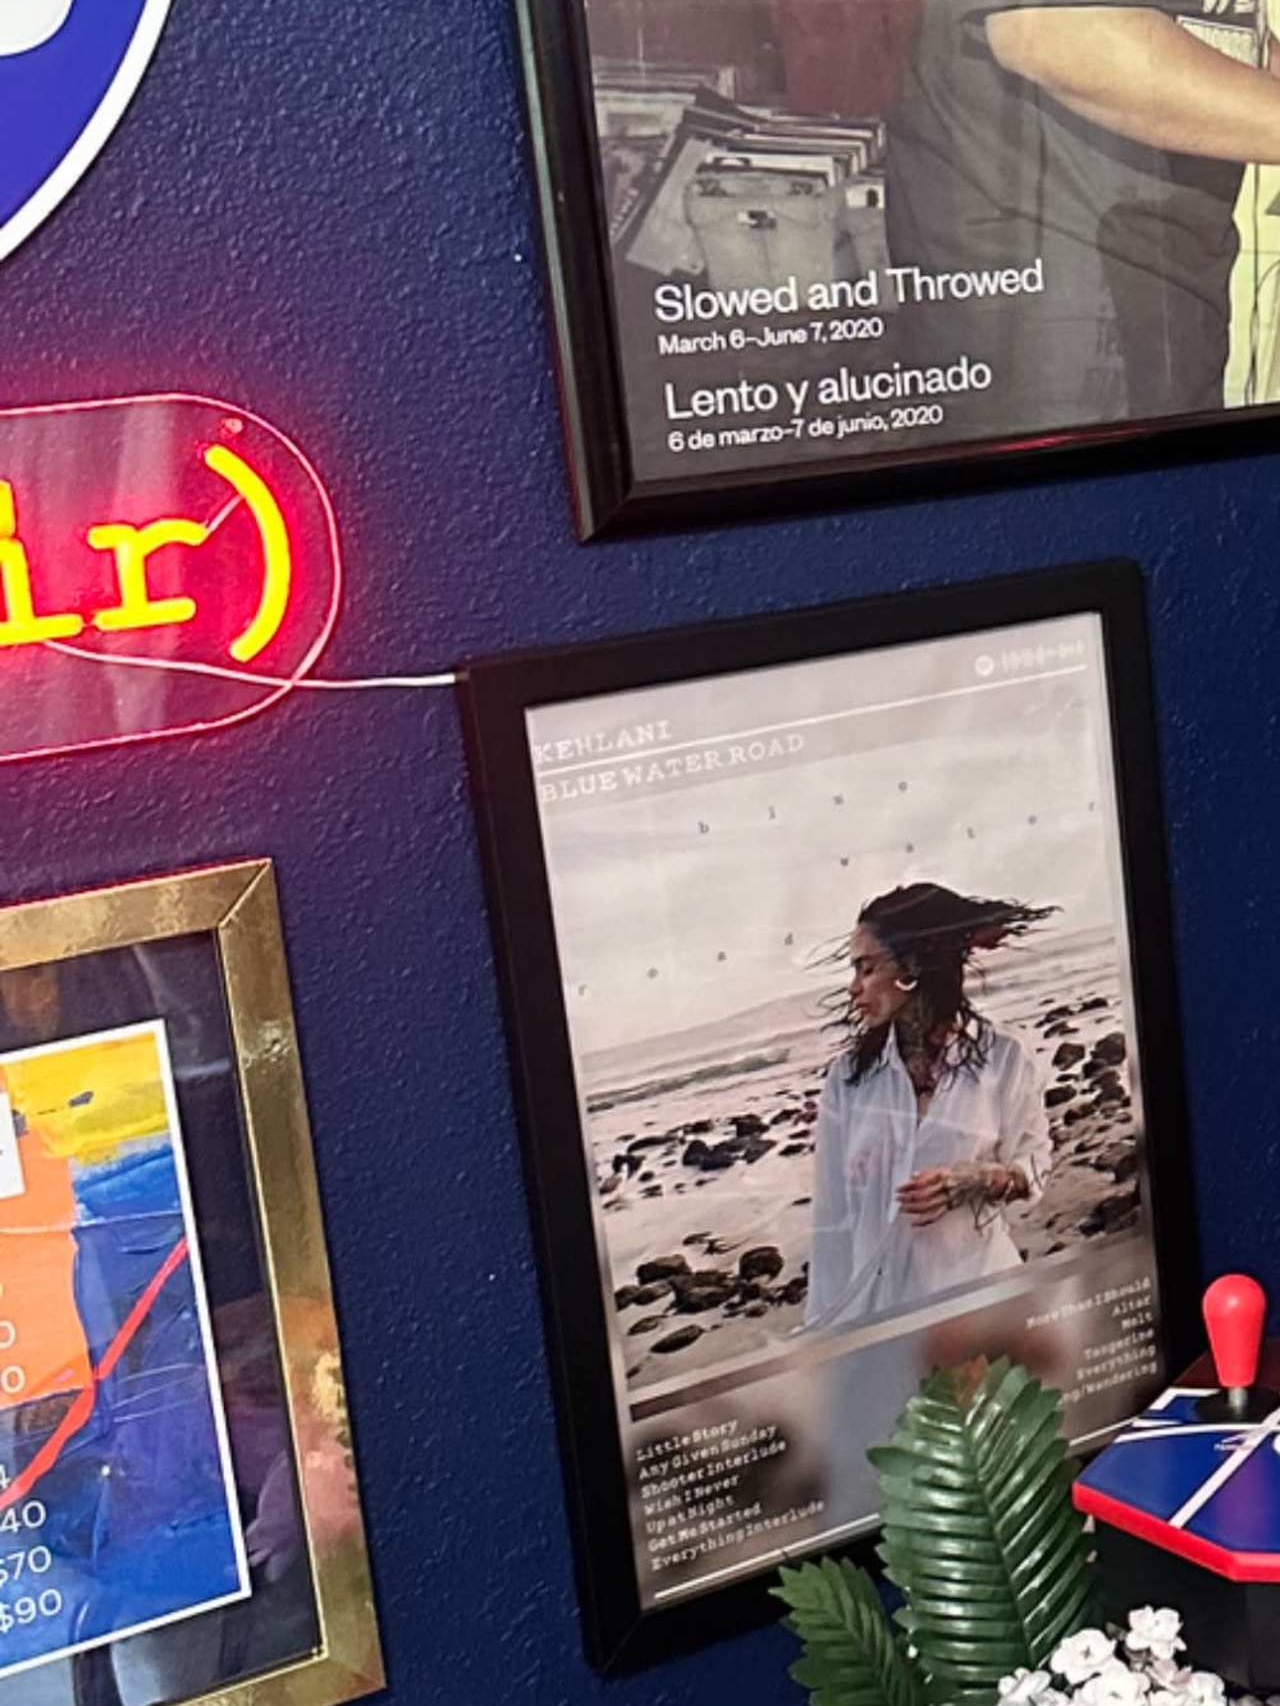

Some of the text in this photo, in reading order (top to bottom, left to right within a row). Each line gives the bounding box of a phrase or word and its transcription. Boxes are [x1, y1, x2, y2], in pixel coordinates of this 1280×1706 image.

[654, 259, 1044, 323] Slowed and Throwed
[659, 331, 727, 355] March
[810, 322, 829, 344] 7,
[831, 317, 883, 339] 2020
[665, 357, 992, 420] Lento y alucinado
[668, 431, 683, 452] 6
[688, 430, 714, 450] de
[808, 416, 834, 435] de
[836, 411, 888, 439] junio,
[891, 405, 943, 429] 2020
[534, 721, 672, 764] KEHLANI
[540, 733, 805, 803] BLUE WATER ROAD
